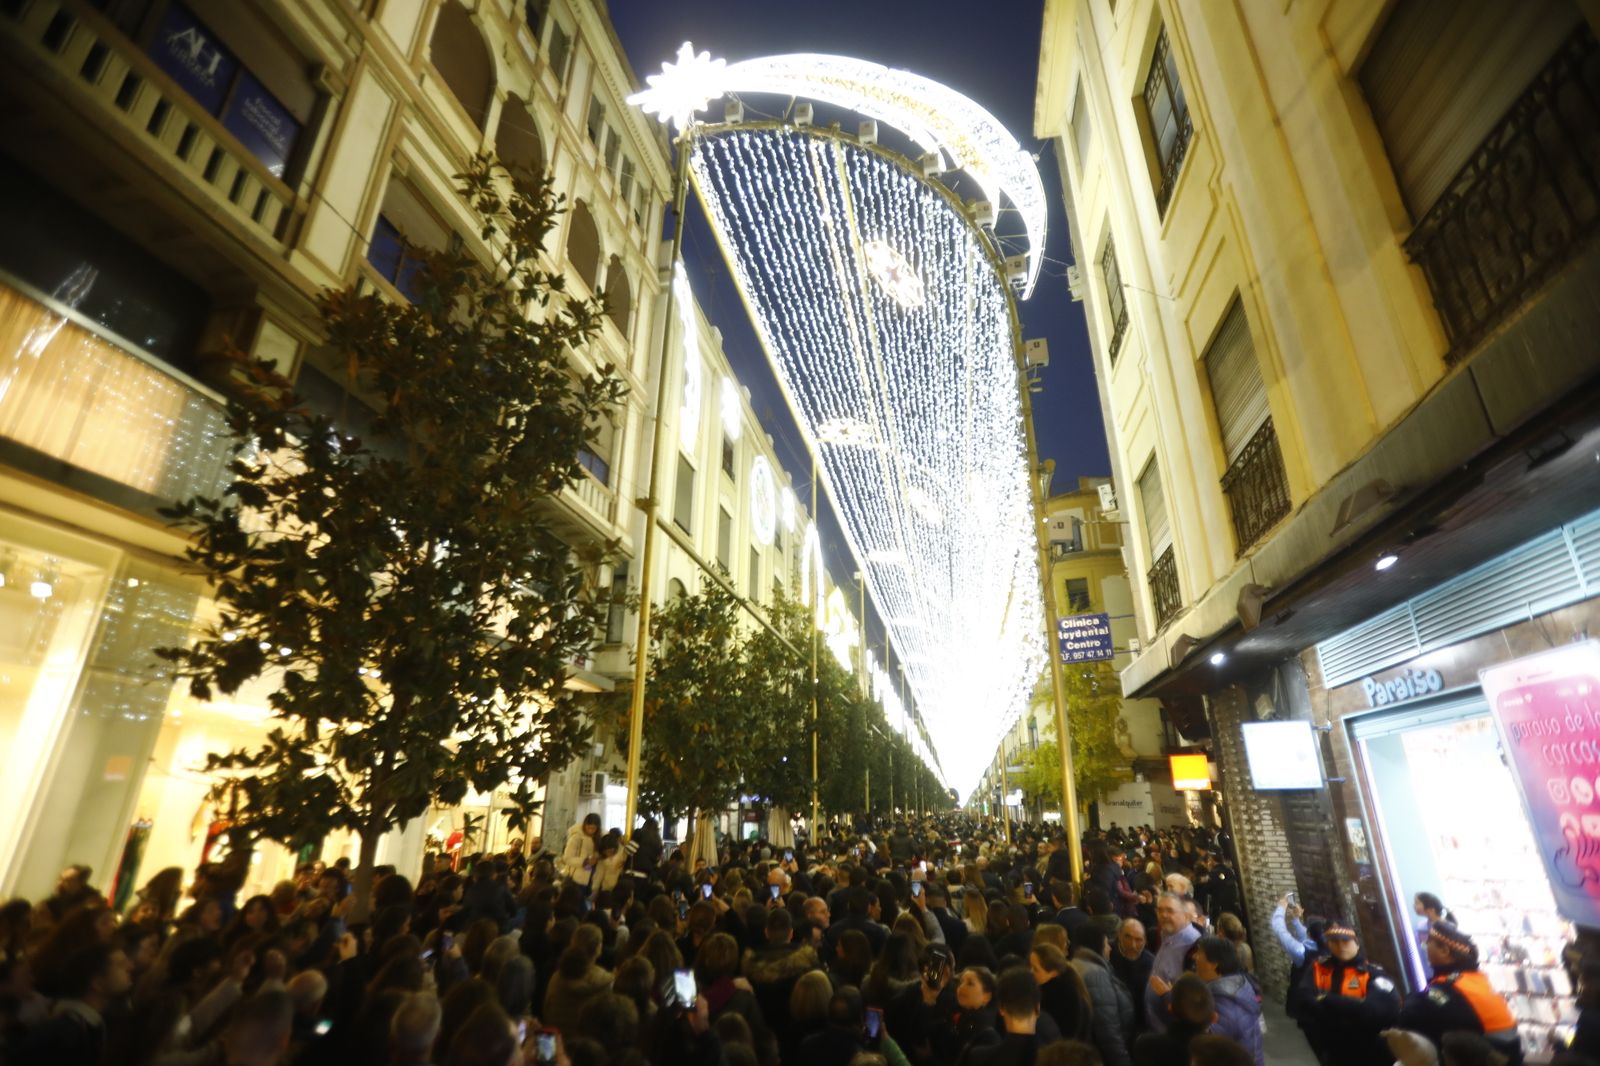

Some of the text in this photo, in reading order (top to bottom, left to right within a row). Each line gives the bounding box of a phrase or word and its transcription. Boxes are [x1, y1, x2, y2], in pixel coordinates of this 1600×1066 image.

[1066, 639, 1101, 650] Centro
[1073, 651, 1085, 660] 957
[1087, 650, 1095, 658] 47
[1364, 669, 1443, 708] Paraiso
[1510, 714, 1562, 746] paraiso
[1563, 702, 1585, 733] de
